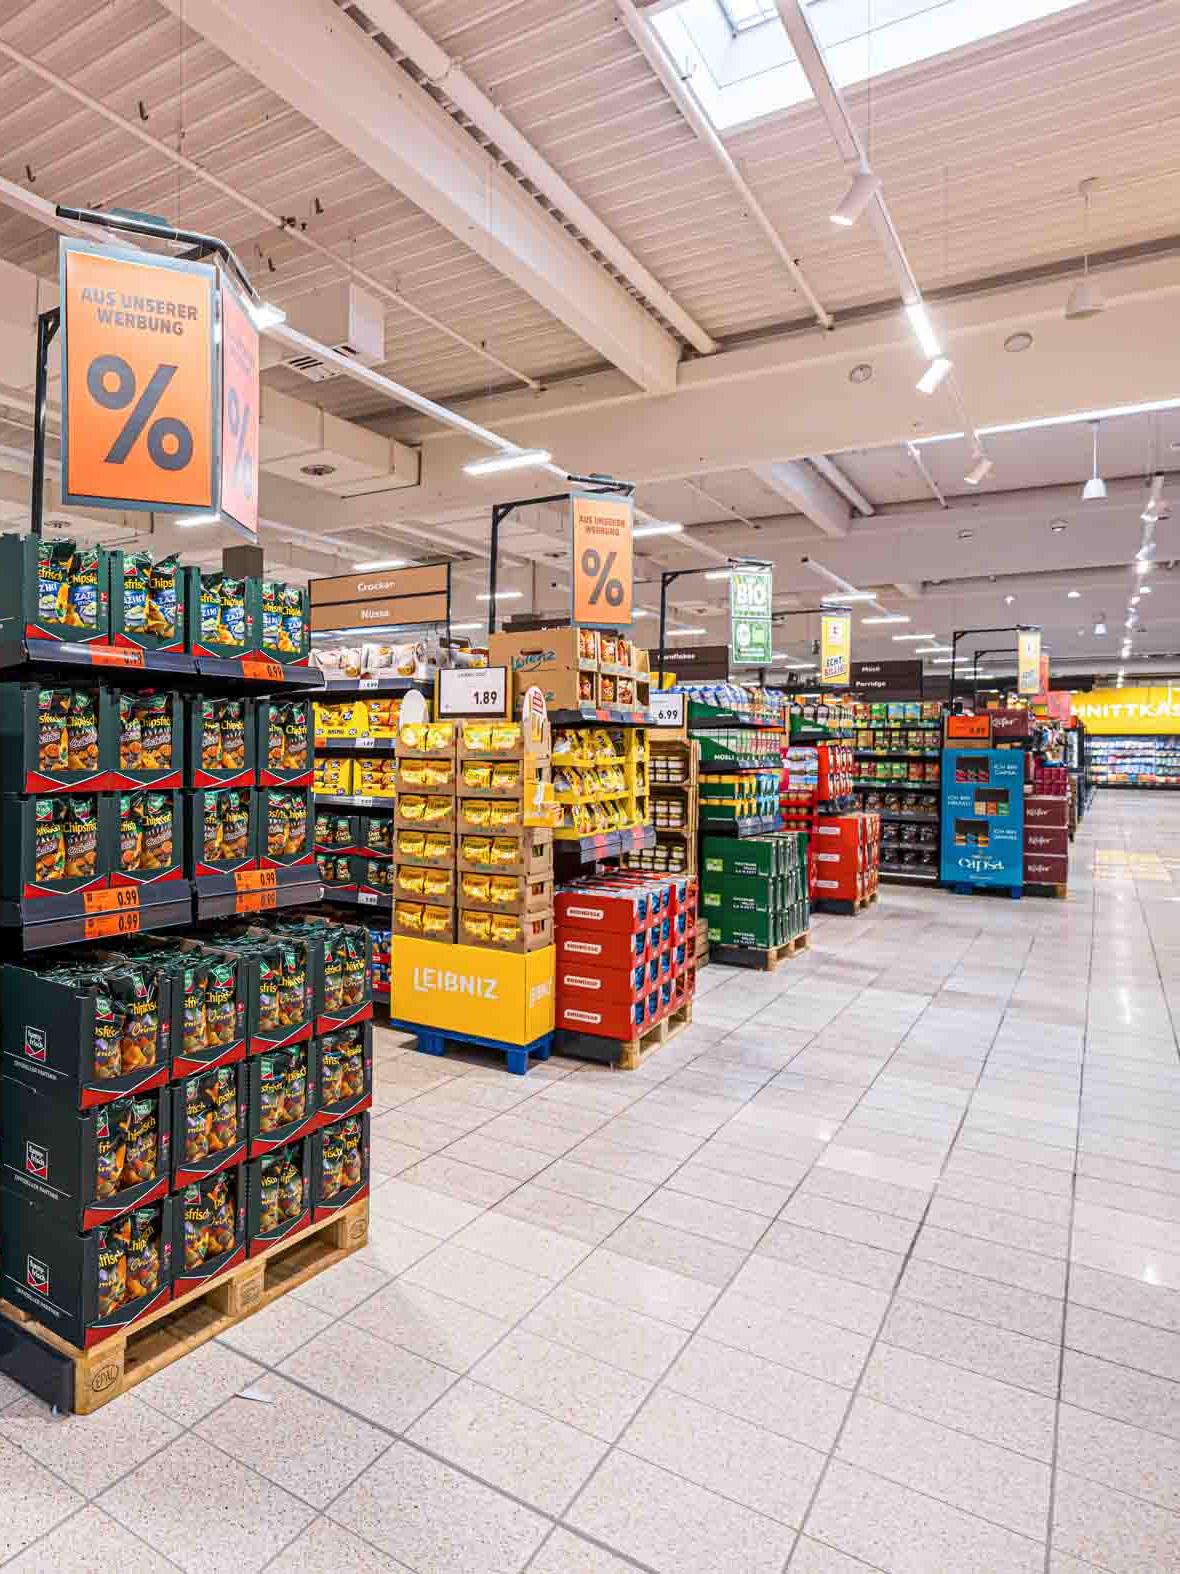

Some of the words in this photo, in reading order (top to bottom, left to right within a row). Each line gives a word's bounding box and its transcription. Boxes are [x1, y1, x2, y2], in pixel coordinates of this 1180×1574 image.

[81, 287, 116, 306] AUS
[121, 294, 198, 321] UNSERER
[97, 308, 184, 336] WERBUNG
[87, 354, 194, 472] %
[357, 580, 396, 593] Cracker
[581, 548, 624, 607] %
[737, 583, 767, 606] BIO
[473, 690, 497, 706] 1.89
[658, 710, 678, 721] 6.99
[1071, 699, 1180, 719] HNITTKÄS
[261, 871, 275, 886] 0.99
[117, 890, 137, 906] 0.99
[119, 914, 138, 931] 0.99
[414, 967, 501, 1000] LEIBNIZ
